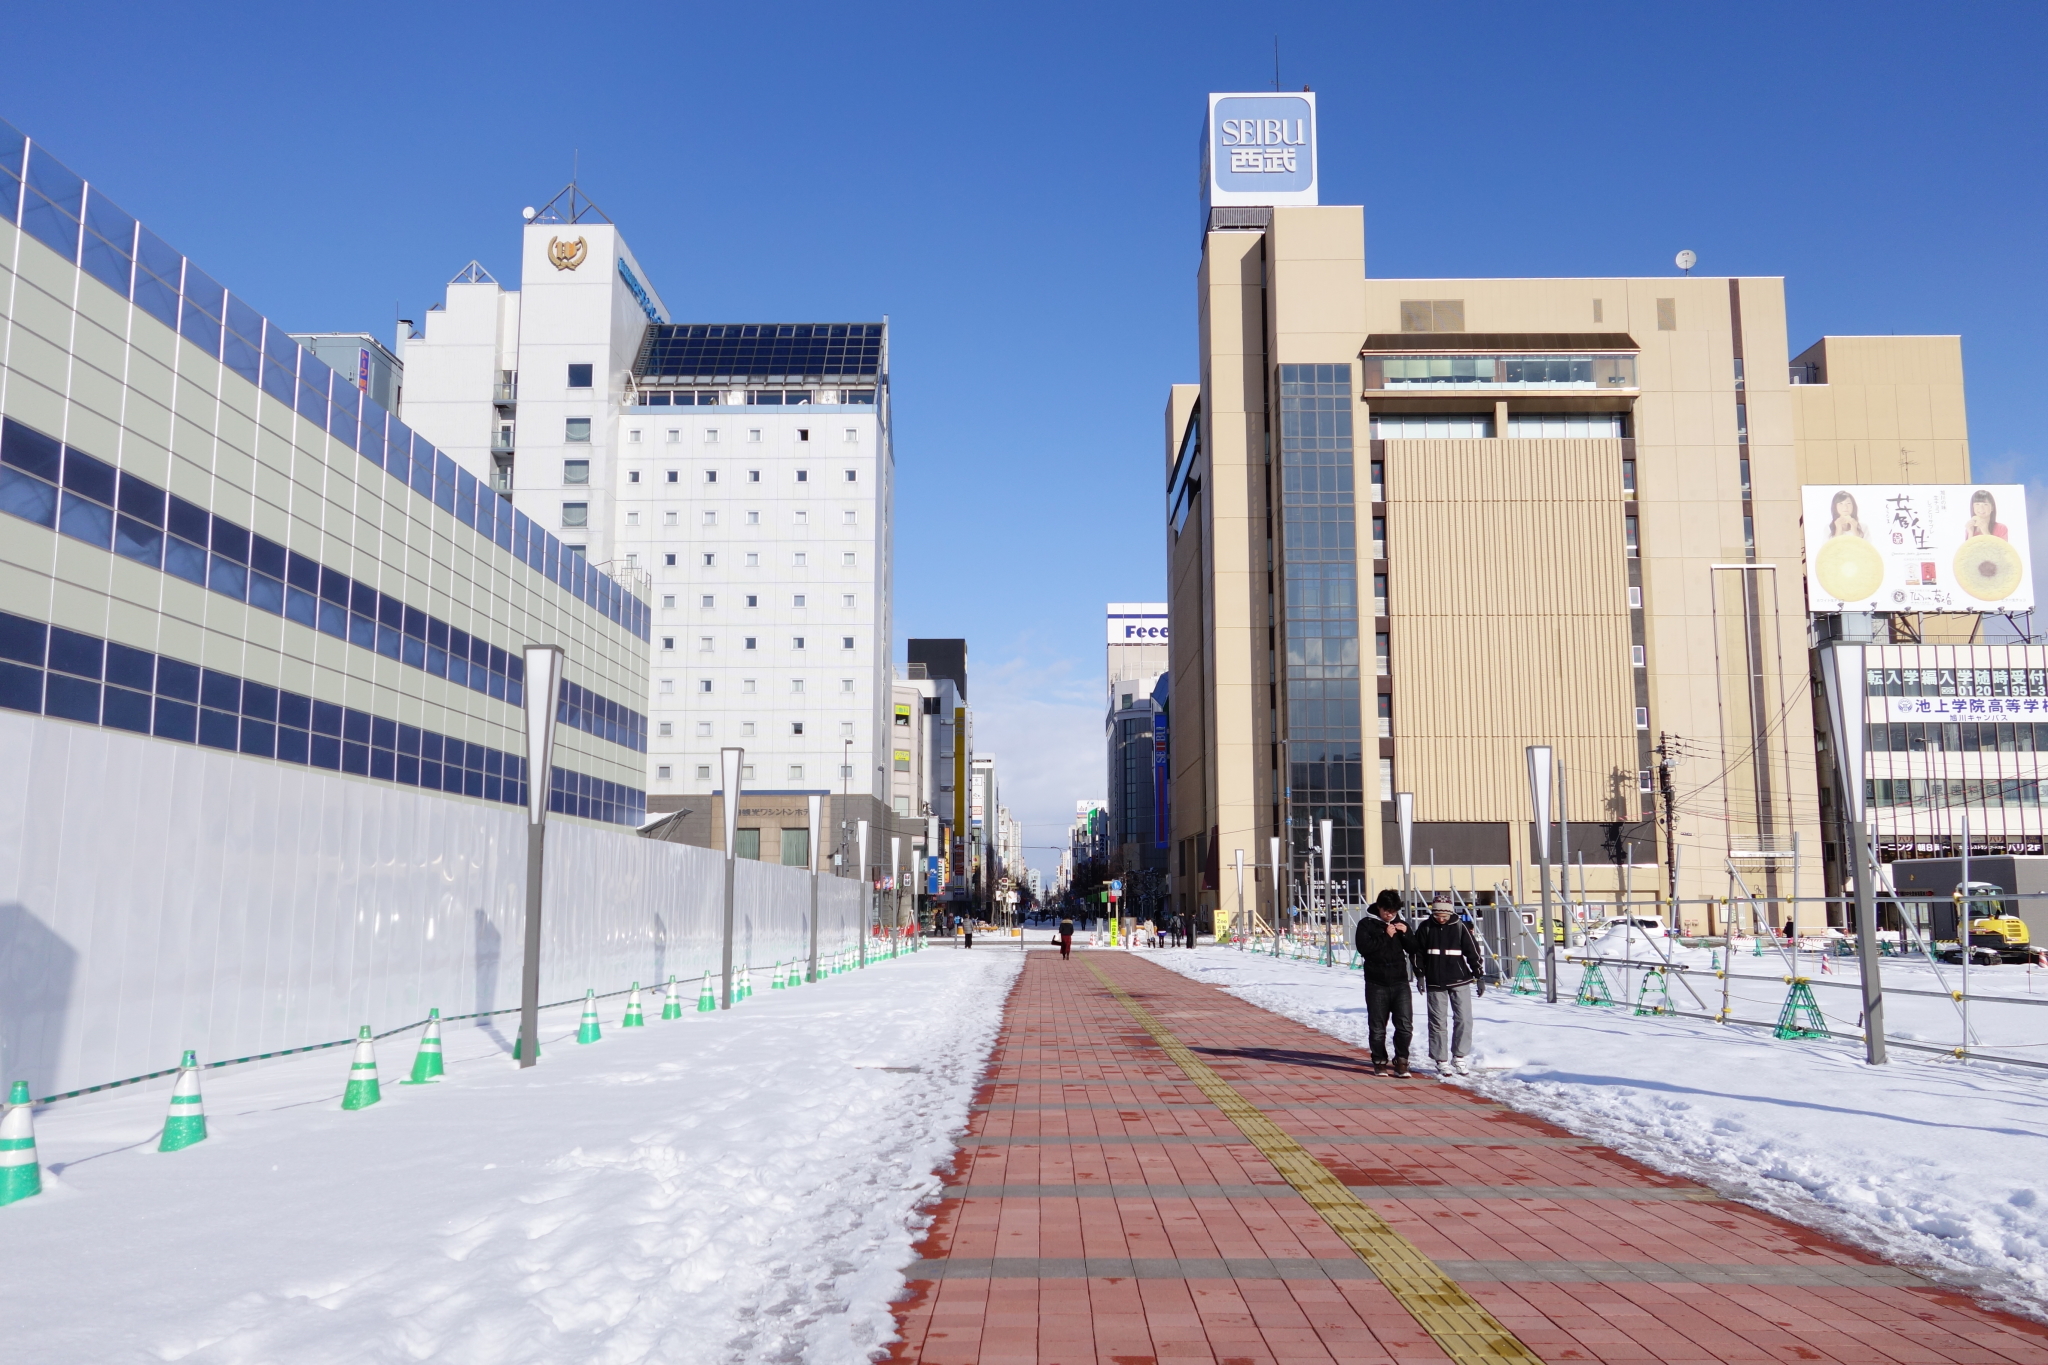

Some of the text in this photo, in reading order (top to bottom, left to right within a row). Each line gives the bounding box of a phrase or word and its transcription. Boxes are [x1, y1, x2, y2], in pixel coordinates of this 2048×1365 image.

[1222, 119, 1306, 146] SEIBU
[1231, 148, 1297, 173] 西武
[1867, 669, 2045, 686] 転入学編入学随時受付
[1156, 726, 1166, 764] SEIBU
[2027, 843, 2041, 852] 2F
